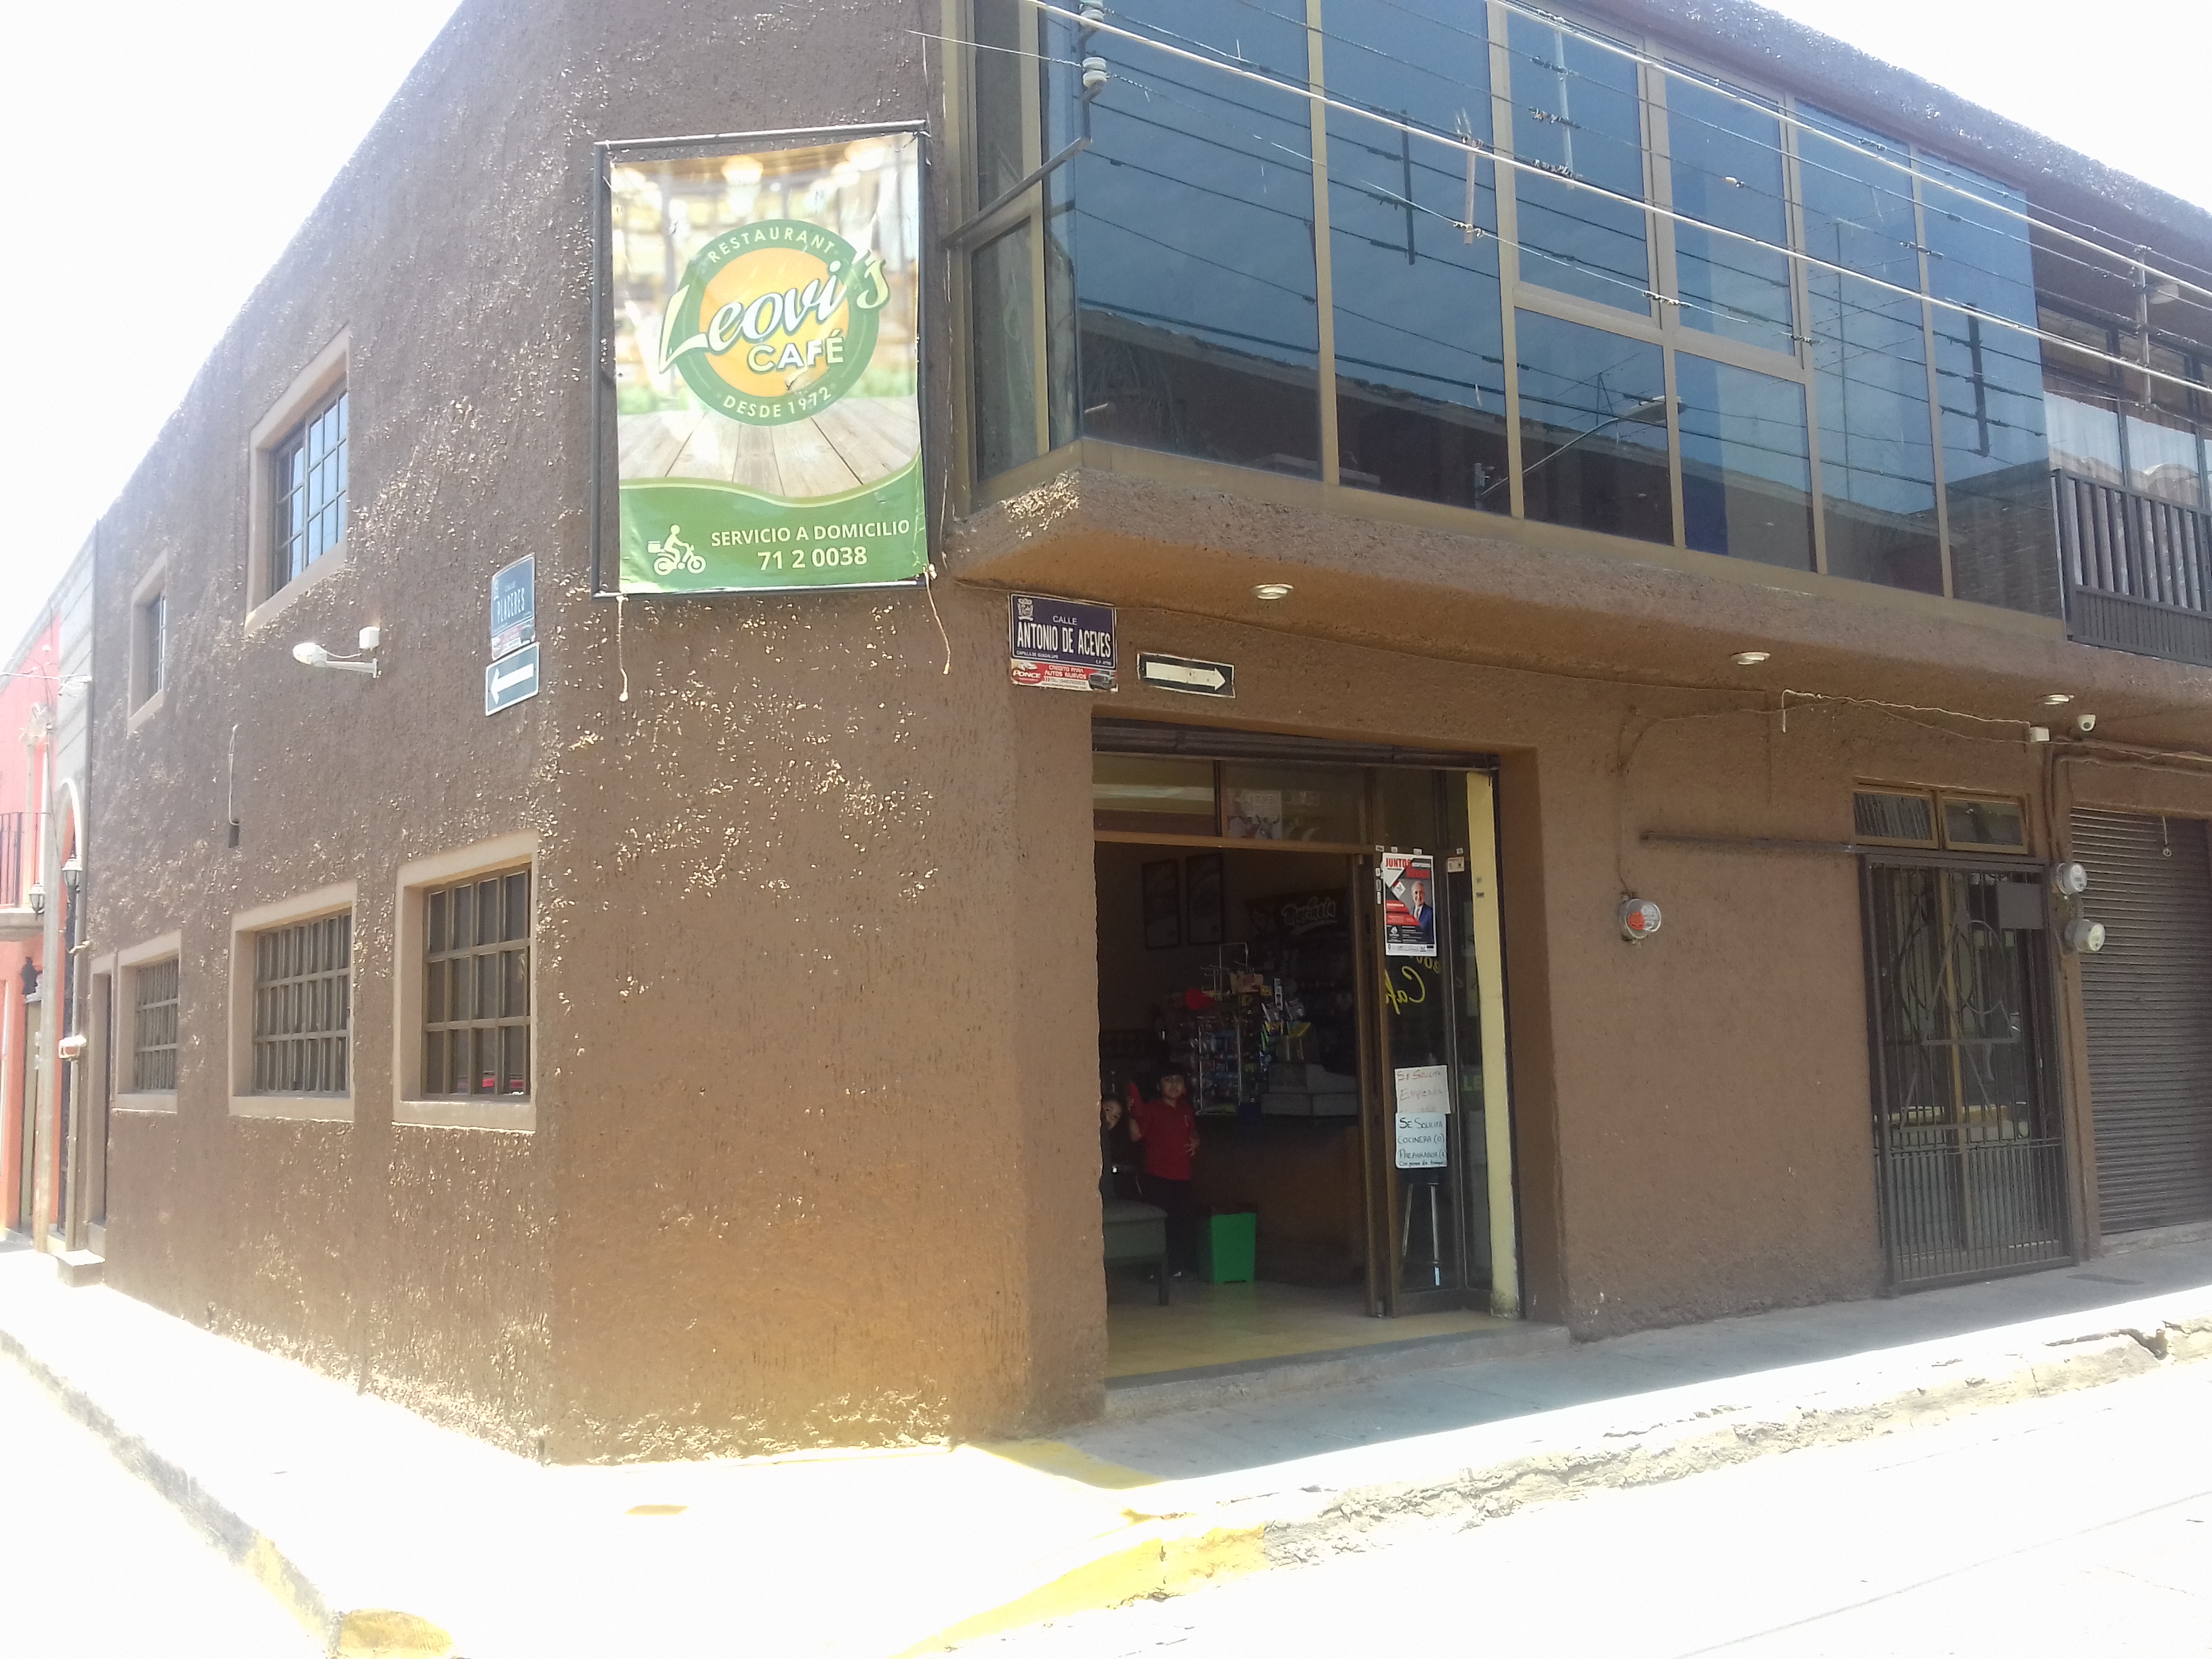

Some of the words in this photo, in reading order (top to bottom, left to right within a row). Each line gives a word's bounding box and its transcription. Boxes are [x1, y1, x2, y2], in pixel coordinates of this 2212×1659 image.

[708, 227, 835, 264] RESTAURANT
[659, 249, 892, 374] Leovi's
[747, 329, 845, 373] CAFÉ
[722, 394, 782, 418] DESDE
[787, 386, 832, 414] 1972
[711, 527, 791, 546] SERVICIO
[796, 526, 809, 541] A
[814, 519, 910, 540] DOMICILIO
[757, 550, 783, 571] 71
[792, 550, 806, 569] 2
[811, 546, 867, 567] 0038
[497, 587, 525, 623] PLACERES
[1052, 615, 1078, 626] CALLE
[1017, 621, 1059, 651] ANTONIO
[1062, 627, 1074, 654] DE
[1078, 629, 1111, 658] ACEVES
[1013, 670, 1041, 678] PONCE
[1044, 669, 1063, 678] AUTOS
[1386, 858, 1412, 868] JUNTOS
[1399, 1117, 1412, 1129] SE
[1397, 1135, 1432, 1145] COCINERA
